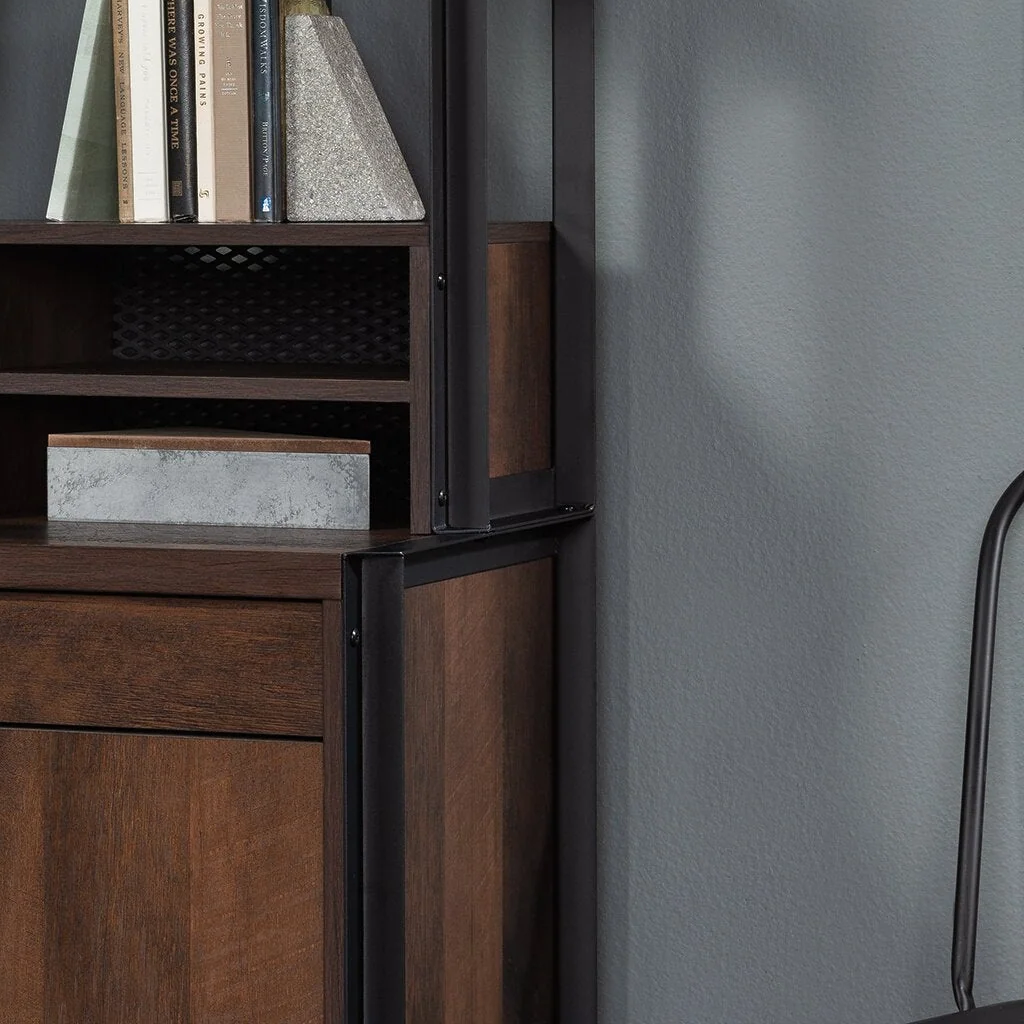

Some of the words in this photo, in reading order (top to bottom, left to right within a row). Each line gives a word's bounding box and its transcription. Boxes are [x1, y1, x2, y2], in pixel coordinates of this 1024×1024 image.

[167, 37, 177, 66] WAS
[197, 14, 206, 65] GROWING
[118, 52, 126, 74] NEW
[168, 69, 178, 103] ONCE
[199, 72, 207, 107] PAINS
[119, 82, 127, 136] LANGUAGE
[170, 106, 179, 116] A
[170, 119, 180, 150] TIME
[121, 143, 129, 190] LESSONS
